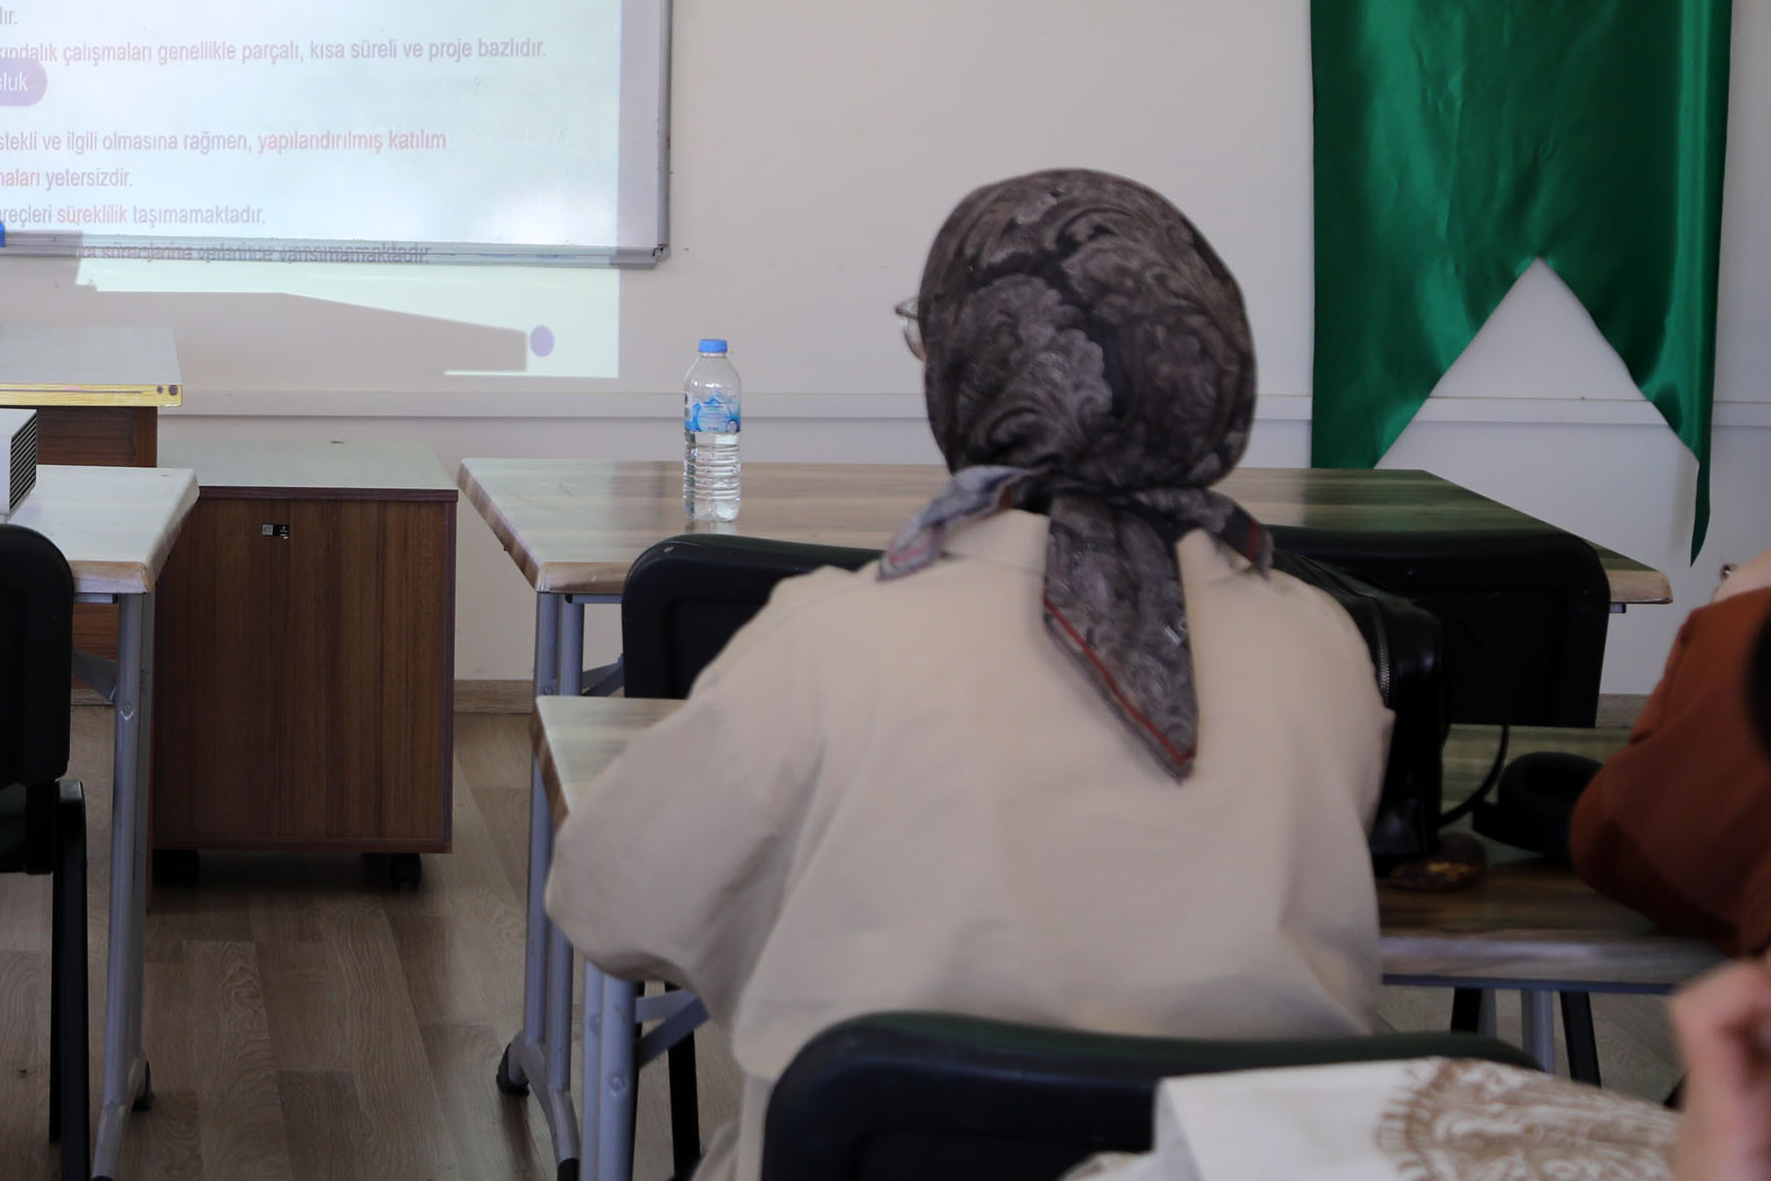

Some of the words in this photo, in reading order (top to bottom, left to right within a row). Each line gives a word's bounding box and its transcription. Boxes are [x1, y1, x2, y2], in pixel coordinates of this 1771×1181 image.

[63, 42, 152, 65] çalışmaları
[158, 41, 236, 65] genellikle
[242, 40, 303, 65] parçalı,
[310, 40, 345, 59] kısa
[351, 39, 397, 59] süreli
[403, 43, 423, 58] ve
[428, 38, 472, 63] proje
[478, 37, 546, 57] bazlıdır.
[42, 135, 62, 150] ve
[67, 131, 97, 155] ilgili
[103, 131, 178, 150] olmasına
[184, 131, 252, 155] rağmen,
[258, 130, 383, 155] yapılandırılmış
[389, 129, 446, 150] katılım
[46, 167, 132, 191] yetersizdir.
[57, 205, 127, 226] süreklilik
[132, 205, 266, 228] taşımamaktadır.
